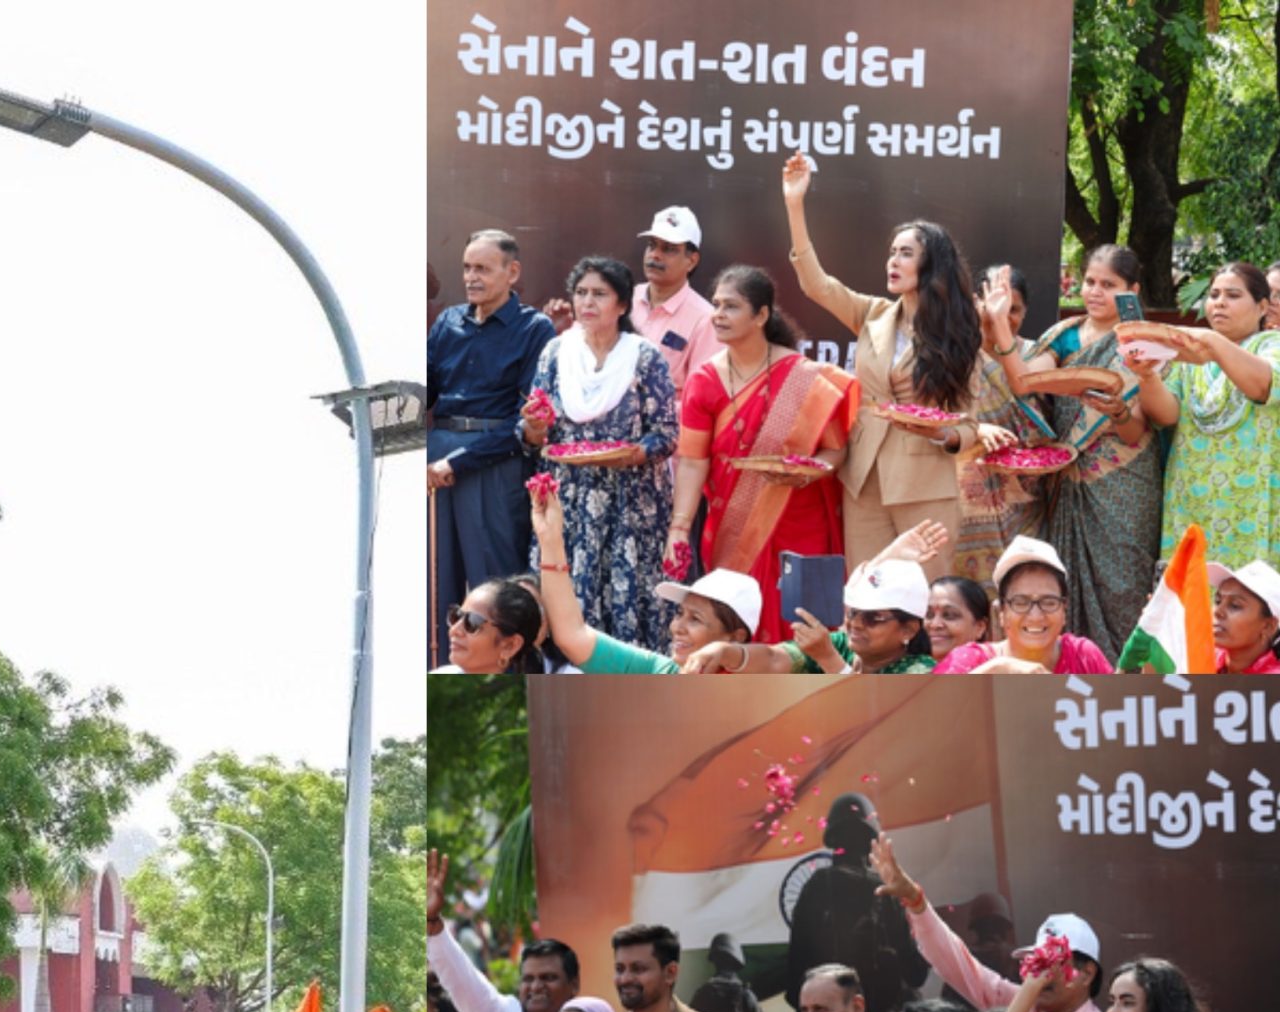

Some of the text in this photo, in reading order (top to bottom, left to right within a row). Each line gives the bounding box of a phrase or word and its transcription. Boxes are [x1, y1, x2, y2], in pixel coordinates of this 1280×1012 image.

[457, 13, 925, 88] સેનાને શત-શત વંદન
[456, 95, 625, 159] મોદીજીને
[637, 100, 734, 170] દેશનું
[867, 108, 1001, 159] સમર્થન
[1054, 675, 1198, 749] સેનાને
[1056, 772, 1237, 849] મોદીજીને
